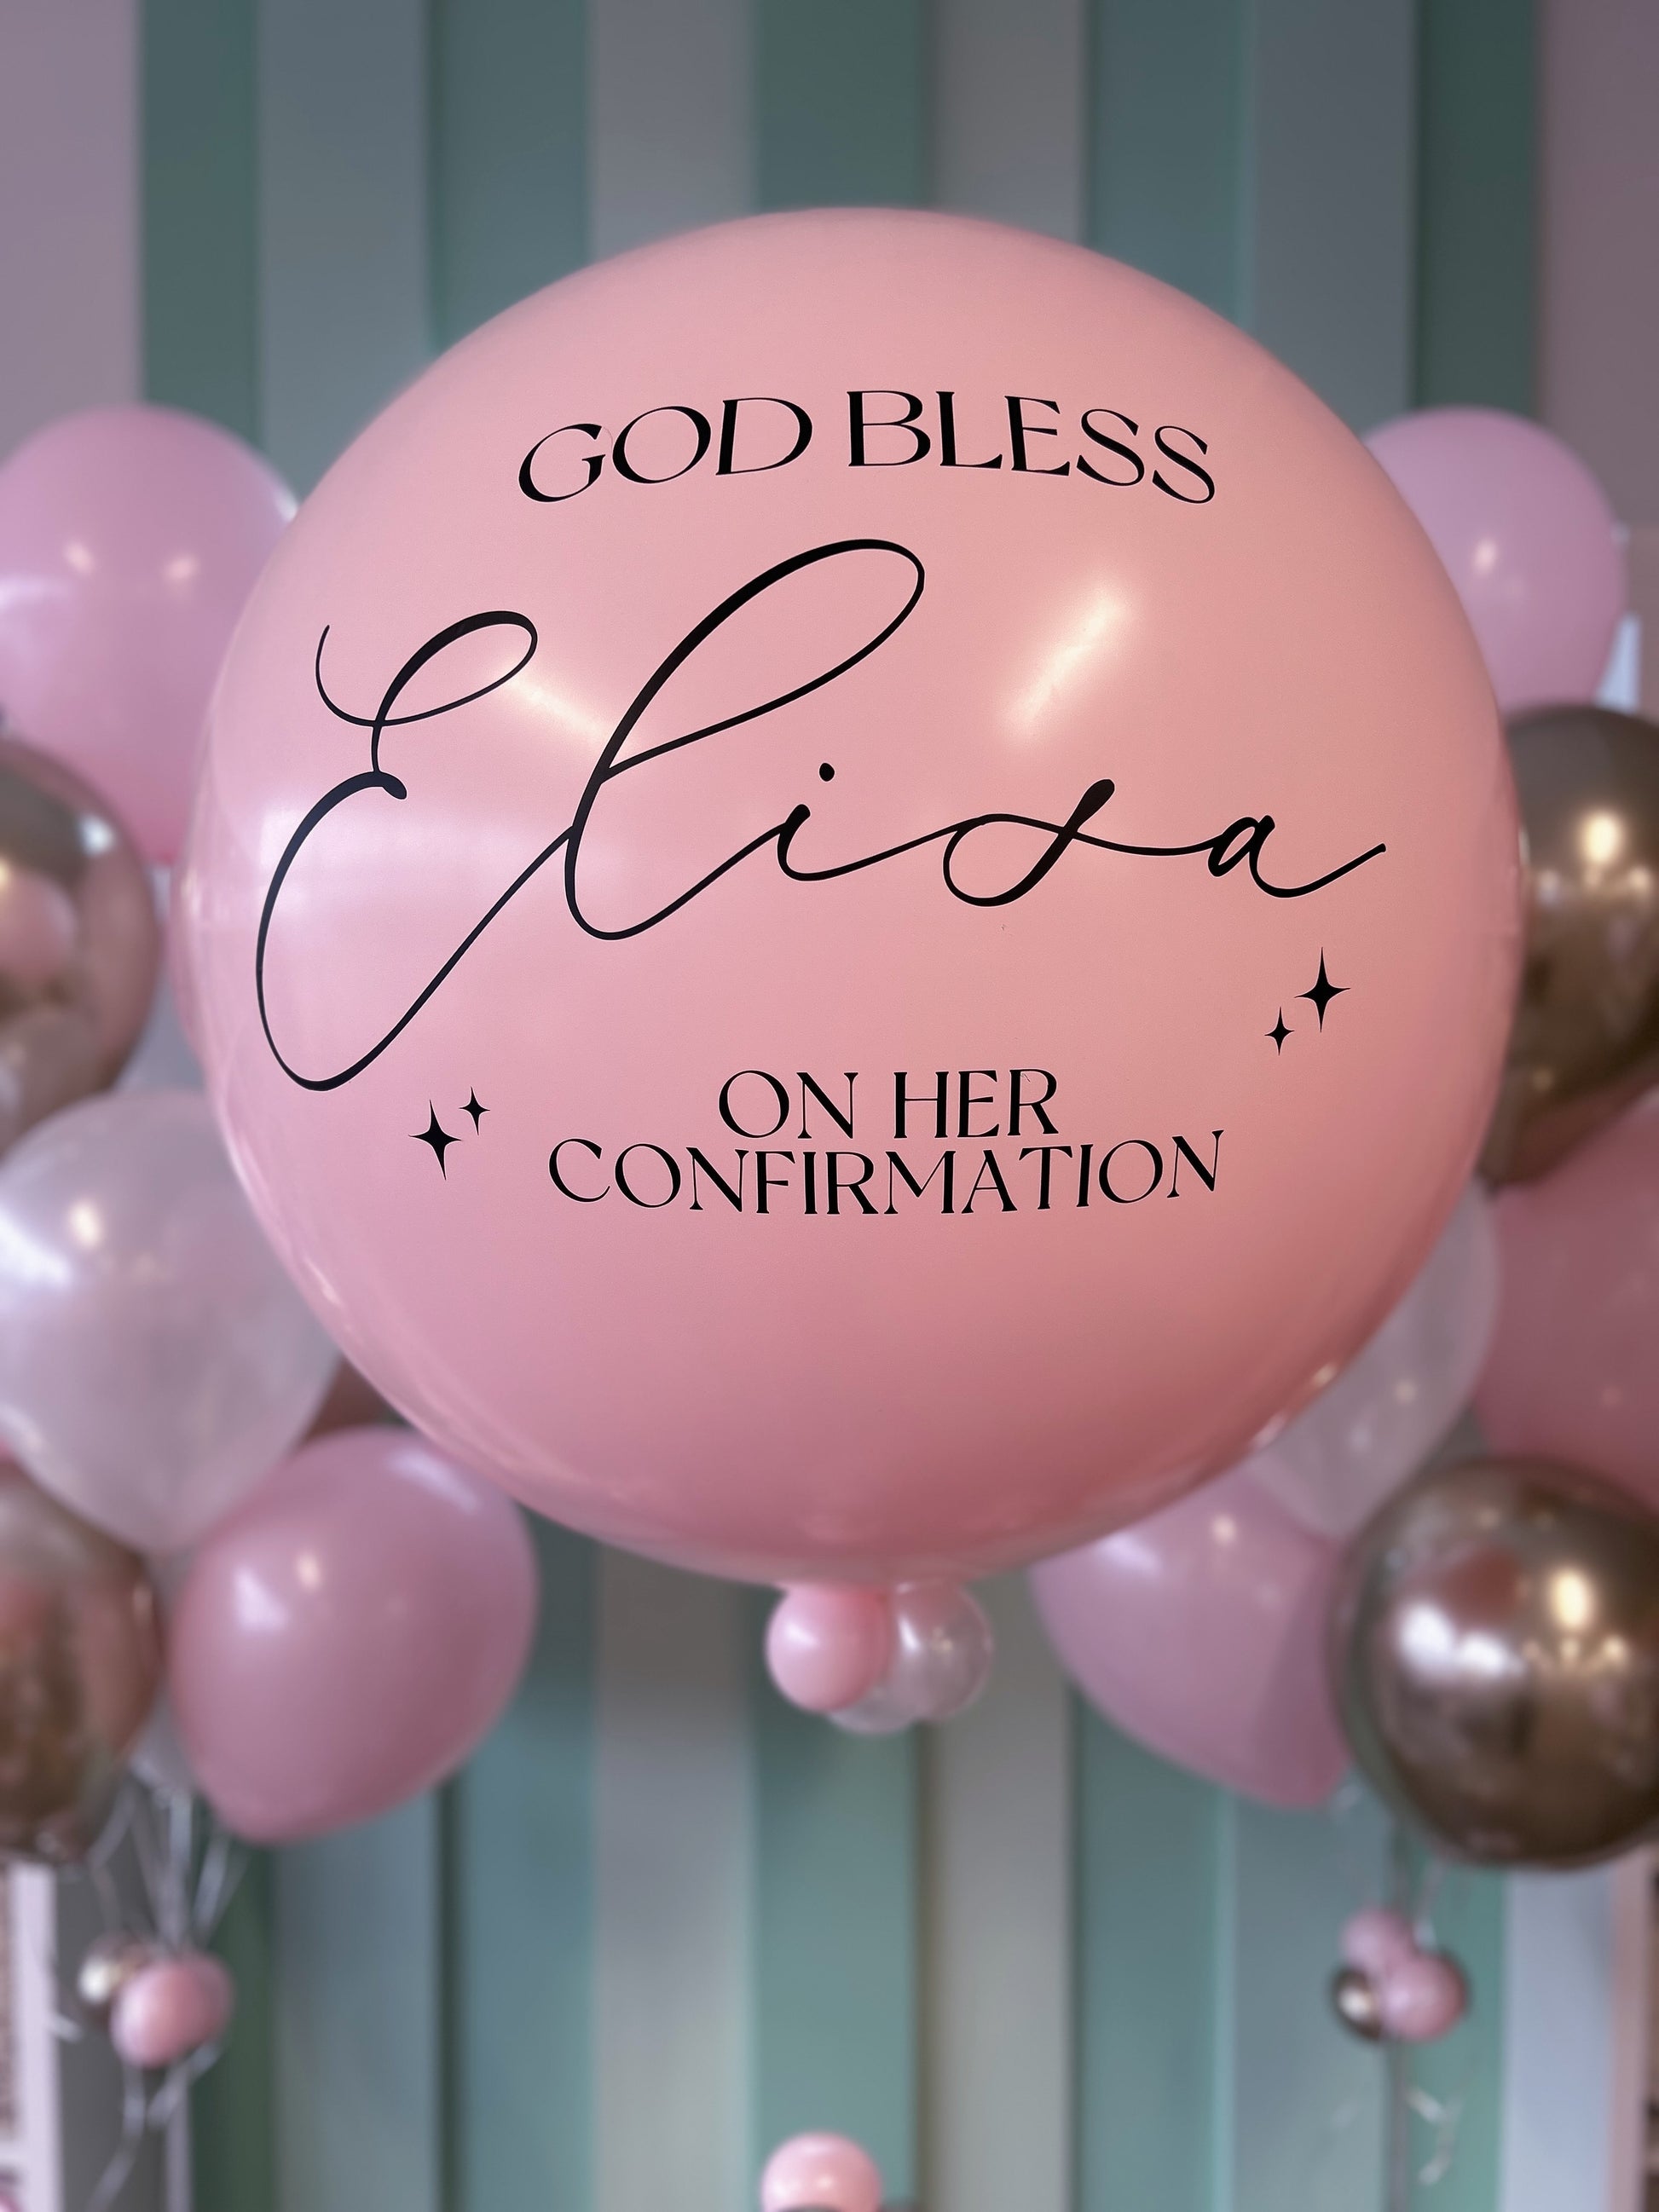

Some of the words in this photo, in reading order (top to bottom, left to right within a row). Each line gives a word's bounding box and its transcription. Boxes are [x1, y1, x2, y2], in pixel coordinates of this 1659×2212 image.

[518, 397, 813, 503] GOD
[846, 390, 1217, 504] BLESS
[256, 539, 1387, 1092] Elisa
[719, 1070, 859, 1140] ON
[893, 1068, 1059, 1139] HER
[548, 1129, 1224, 1215] CONFIRMATION
